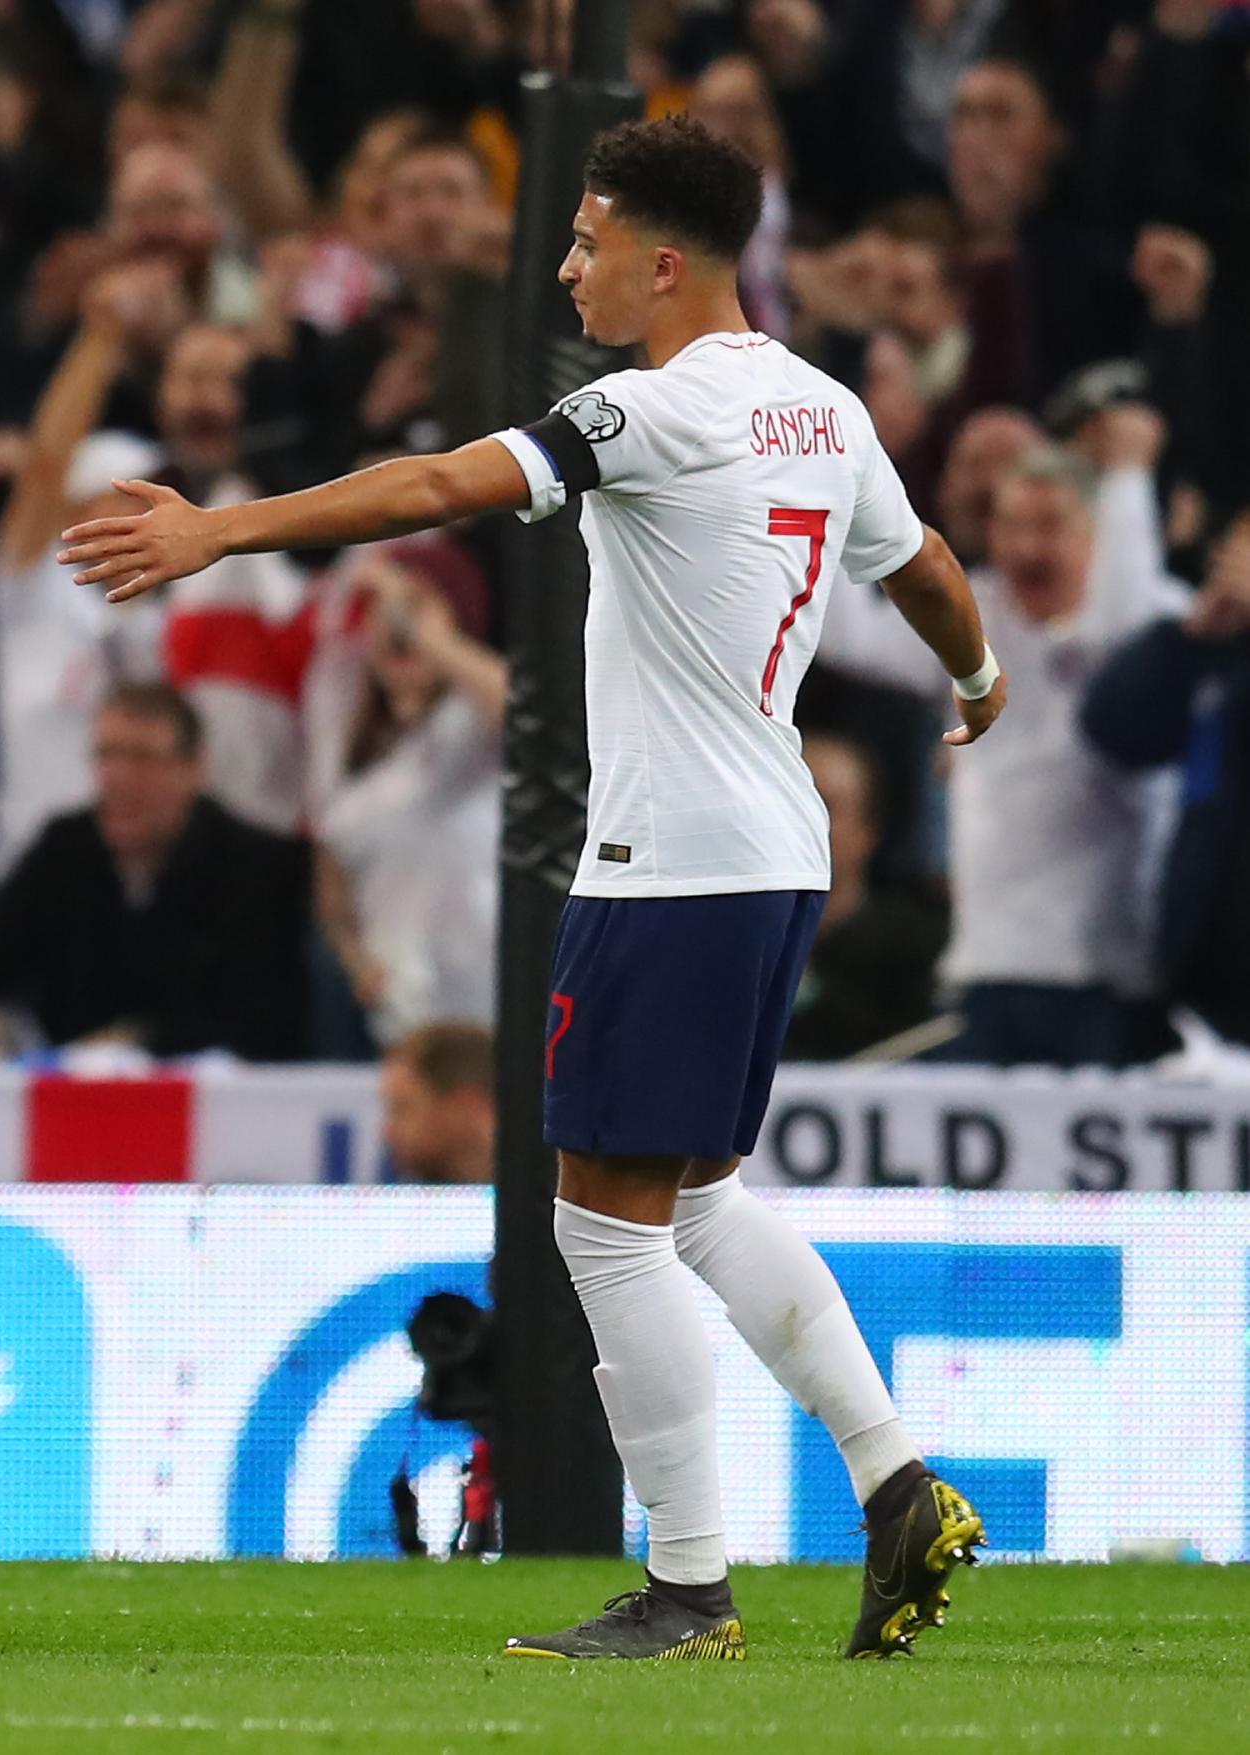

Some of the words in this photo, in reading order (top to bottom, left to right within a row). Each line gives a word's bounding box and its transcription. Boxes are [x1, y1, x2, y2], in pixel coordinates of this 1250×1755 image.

[749, 406, 846, 457] SANCHO
[759, 507, 832, 718] 7
[546, 991, 575, 1080] 7
[770, 1104, 1012, 1189] OLD
